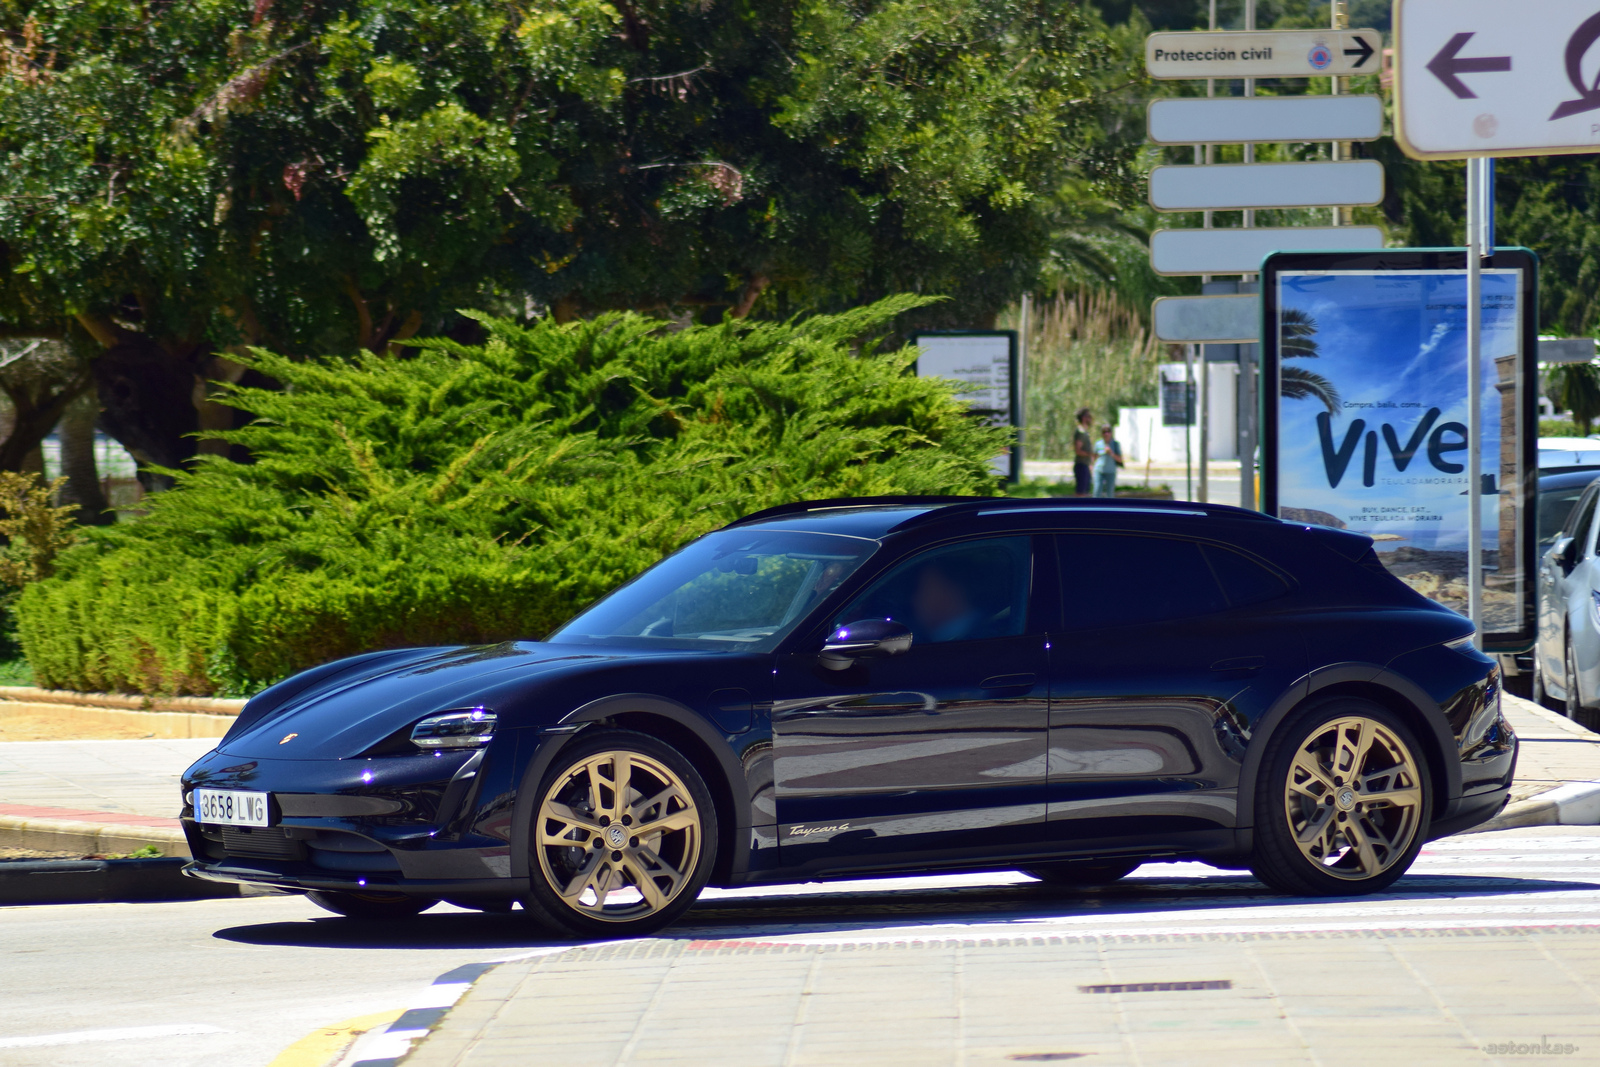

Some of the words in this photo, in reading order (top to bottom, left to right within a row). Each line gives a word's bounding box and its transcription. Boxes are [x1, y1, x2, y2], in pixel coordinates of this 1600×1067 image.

[1154, 48, 1236, 62] Protección
[1241, 47, 1273, 60] civil
[1343, 401, 1375, 410] Compra,
[1407, 514, 1443, 522] MORAIRA
[203, 794, 233, 819] 3658
[237, 796, 263, 821] LWG
